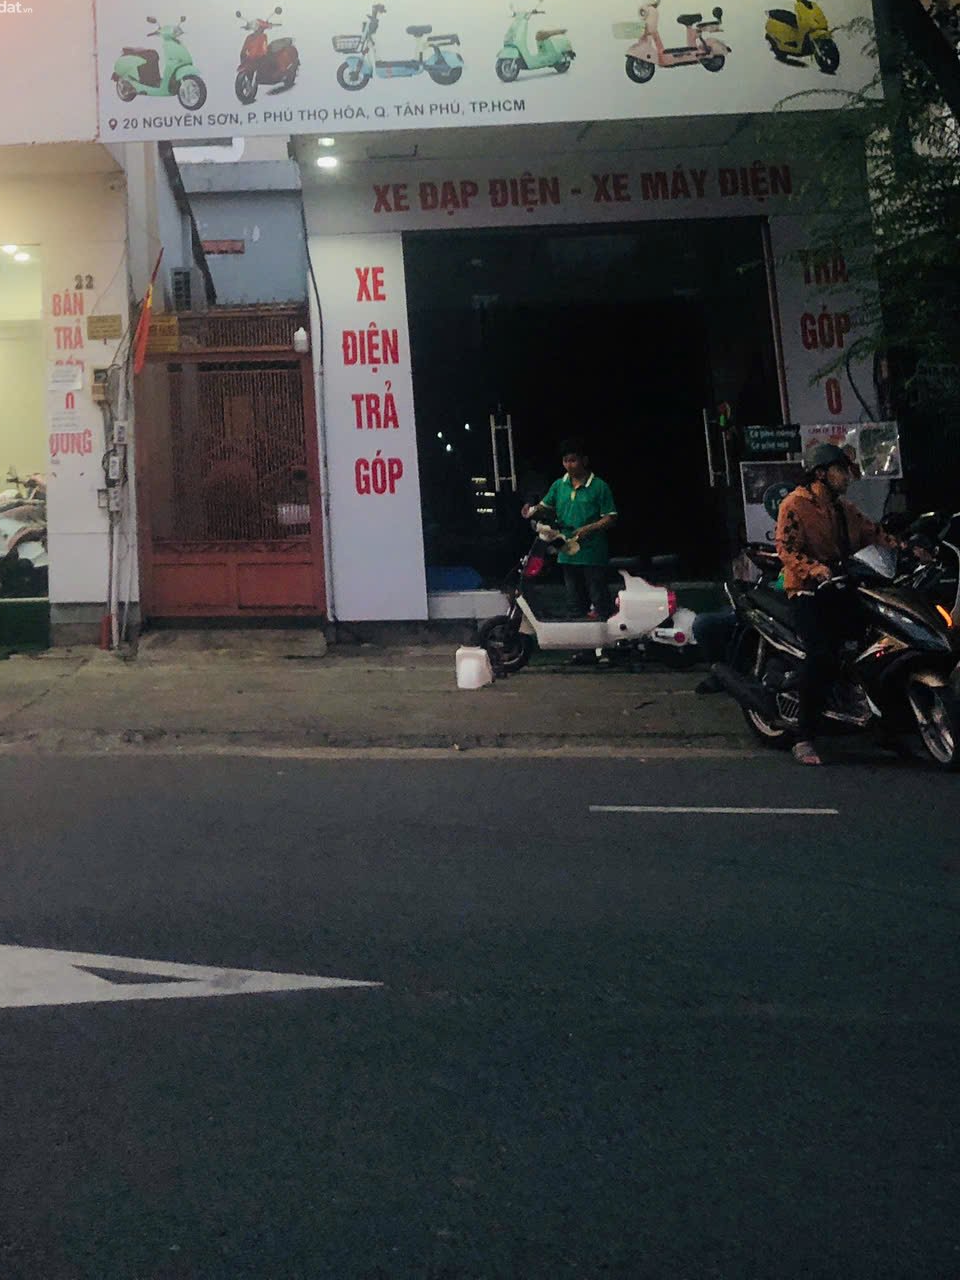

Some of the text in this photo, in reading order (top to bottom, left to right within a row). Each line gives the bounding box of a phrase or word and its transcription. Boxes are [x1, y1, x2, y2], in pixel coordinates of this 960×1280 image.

[123, 118, 138, 130] 20
[143, 113, 203, 129] NGUYỄN
[207, 113, 242, 127] SƠN,
[248, 114, 259, 125] P.
[263, 109, 293, 123] PHÚ
[298, 108, 329, 124] THỌ
[375, 106, 390, 118] Q.
[394, 101, 424, 117] TÂN
[470, 99, 526, 113] TP.HCM
[373, 182, 409, 213] XE
[418, 180, 479, 216] ĐẠP
[488, 171, 561, 213] ĐIỆN
[592, 173, 631, 203] XE
[641, 163, 709, 200] MÁY
[718, 160, 793, 203] ĐIỆN
[75, 274, 94, 290] 22
[355, 267, 386, 302] XE
[52, 288, 85, 317] BÁN
[54, 317, 84, 350] TRẢ
[801, 303, 850, 350] GÓP
[342, 321, 399, 373] ĐIỆN
[352, 380, 399, 430] TRẢ
[355, 450, 403, 495] GÓP
